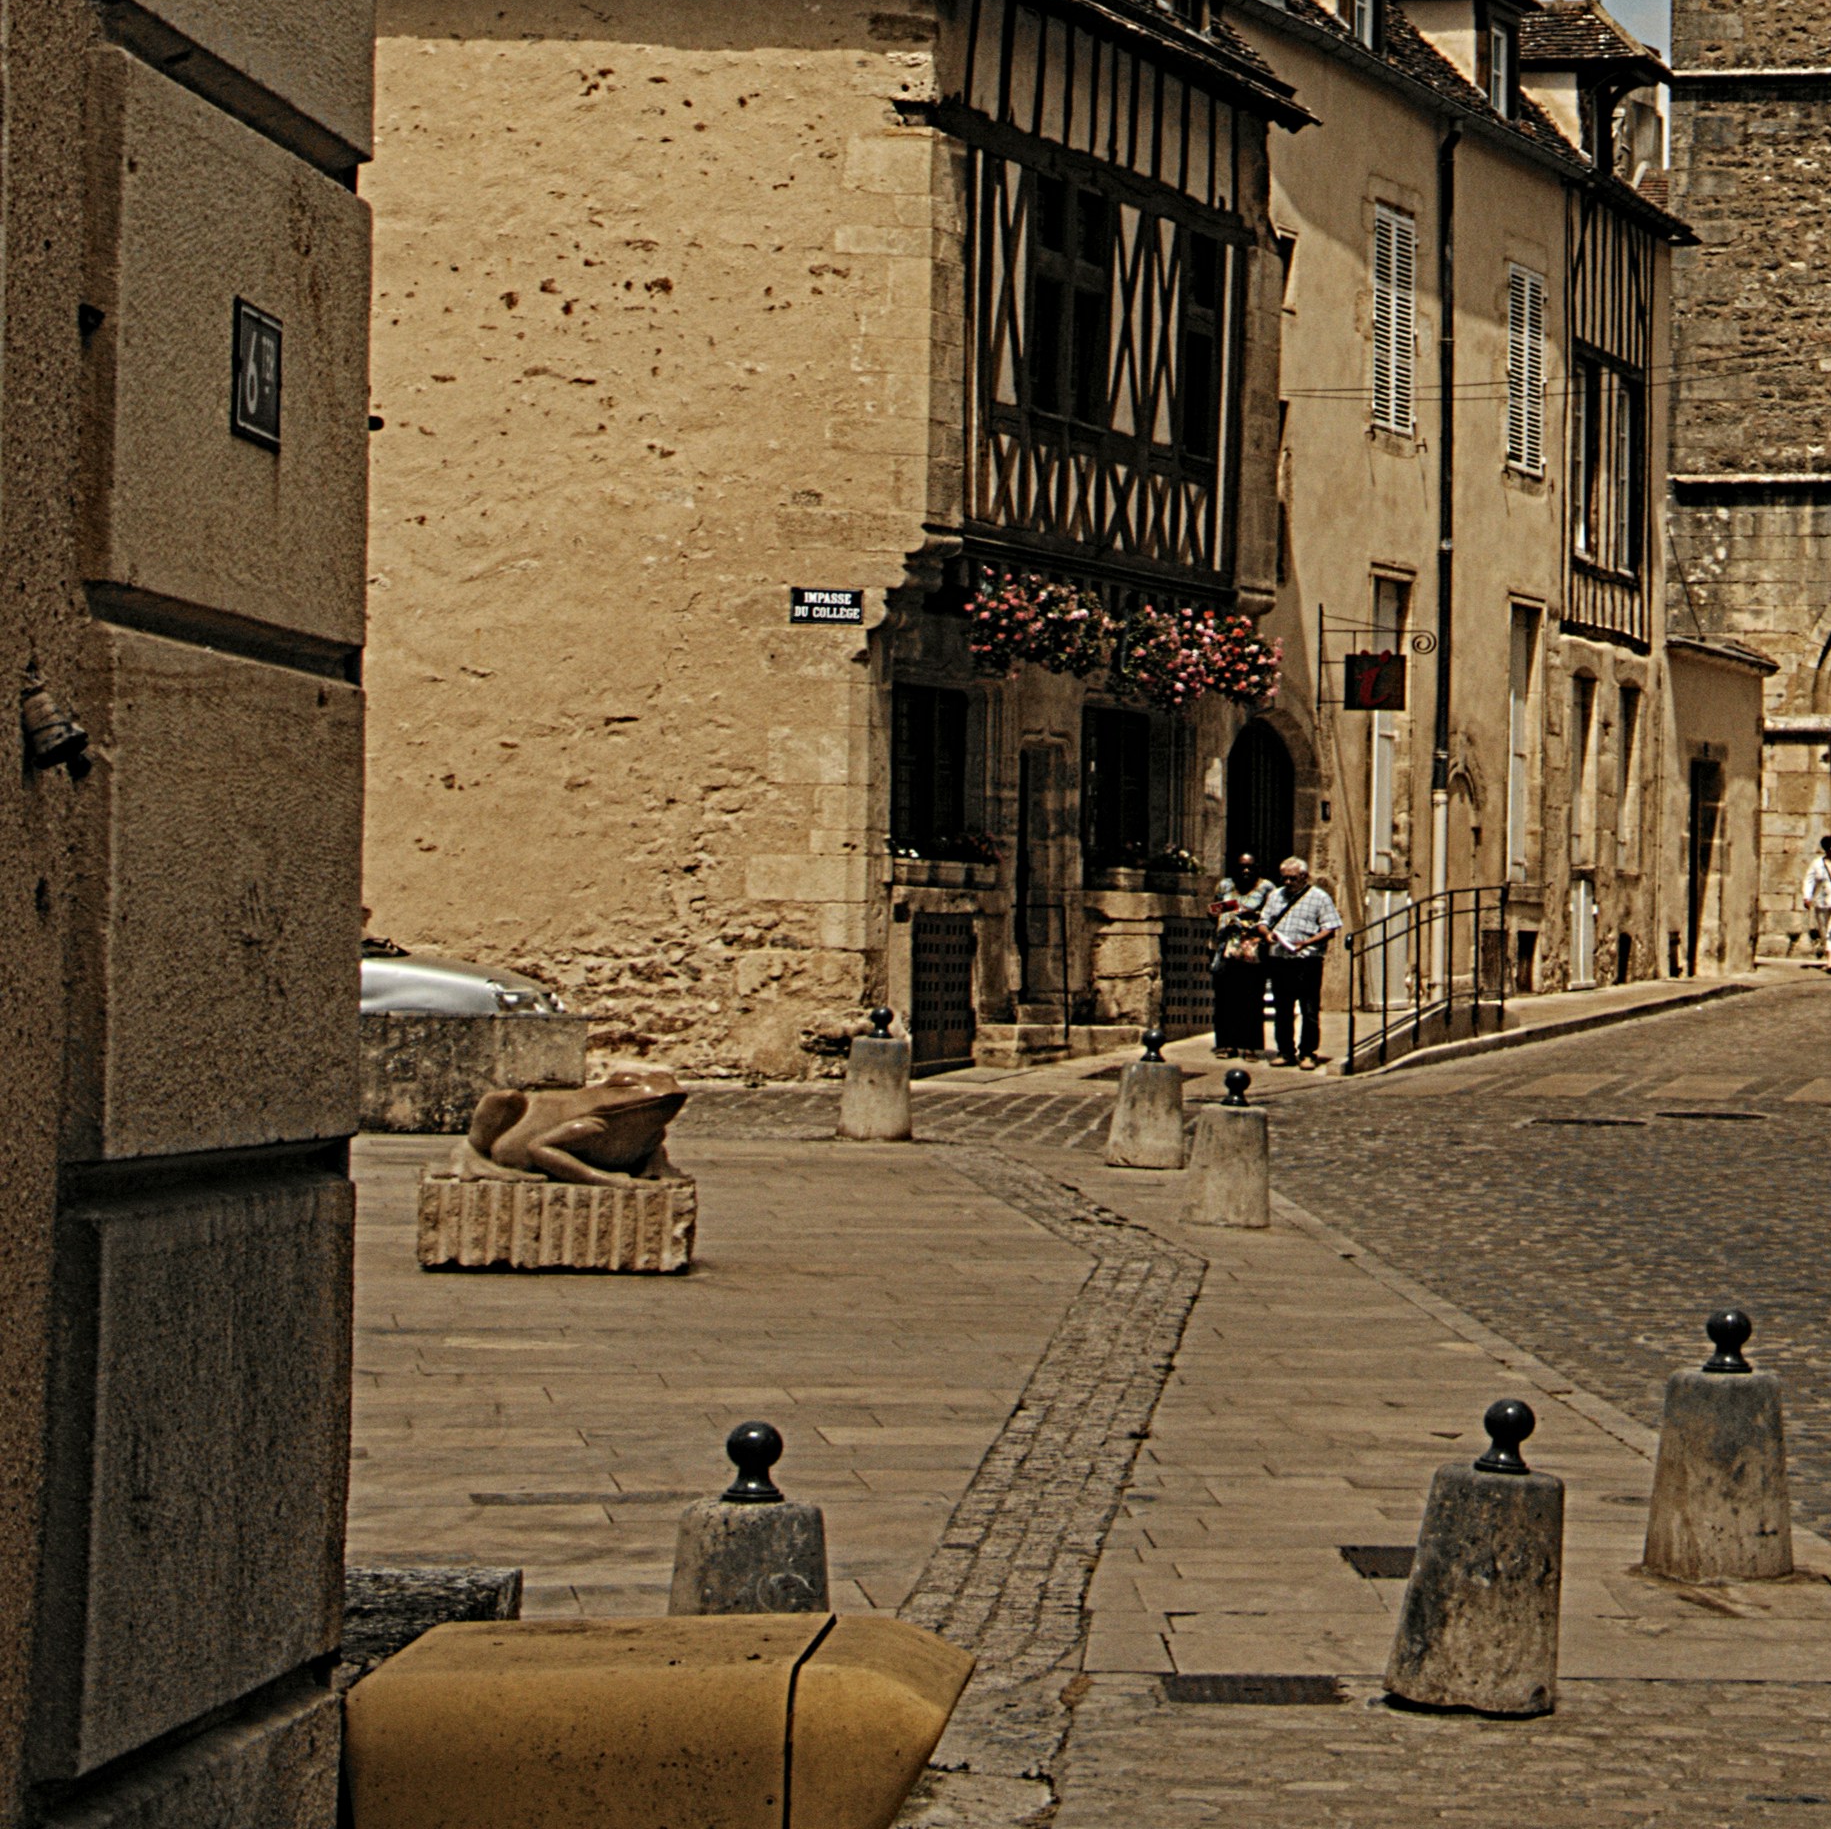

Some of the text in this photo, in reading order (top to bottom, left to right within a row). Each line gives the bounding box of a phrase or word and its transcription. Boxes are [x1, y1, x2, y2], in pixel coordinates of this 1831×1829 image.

[247, 331, 258, 414] 6
[803, 591, 852, 605] IMPASSE
[794, 605, 809, 617] DU
